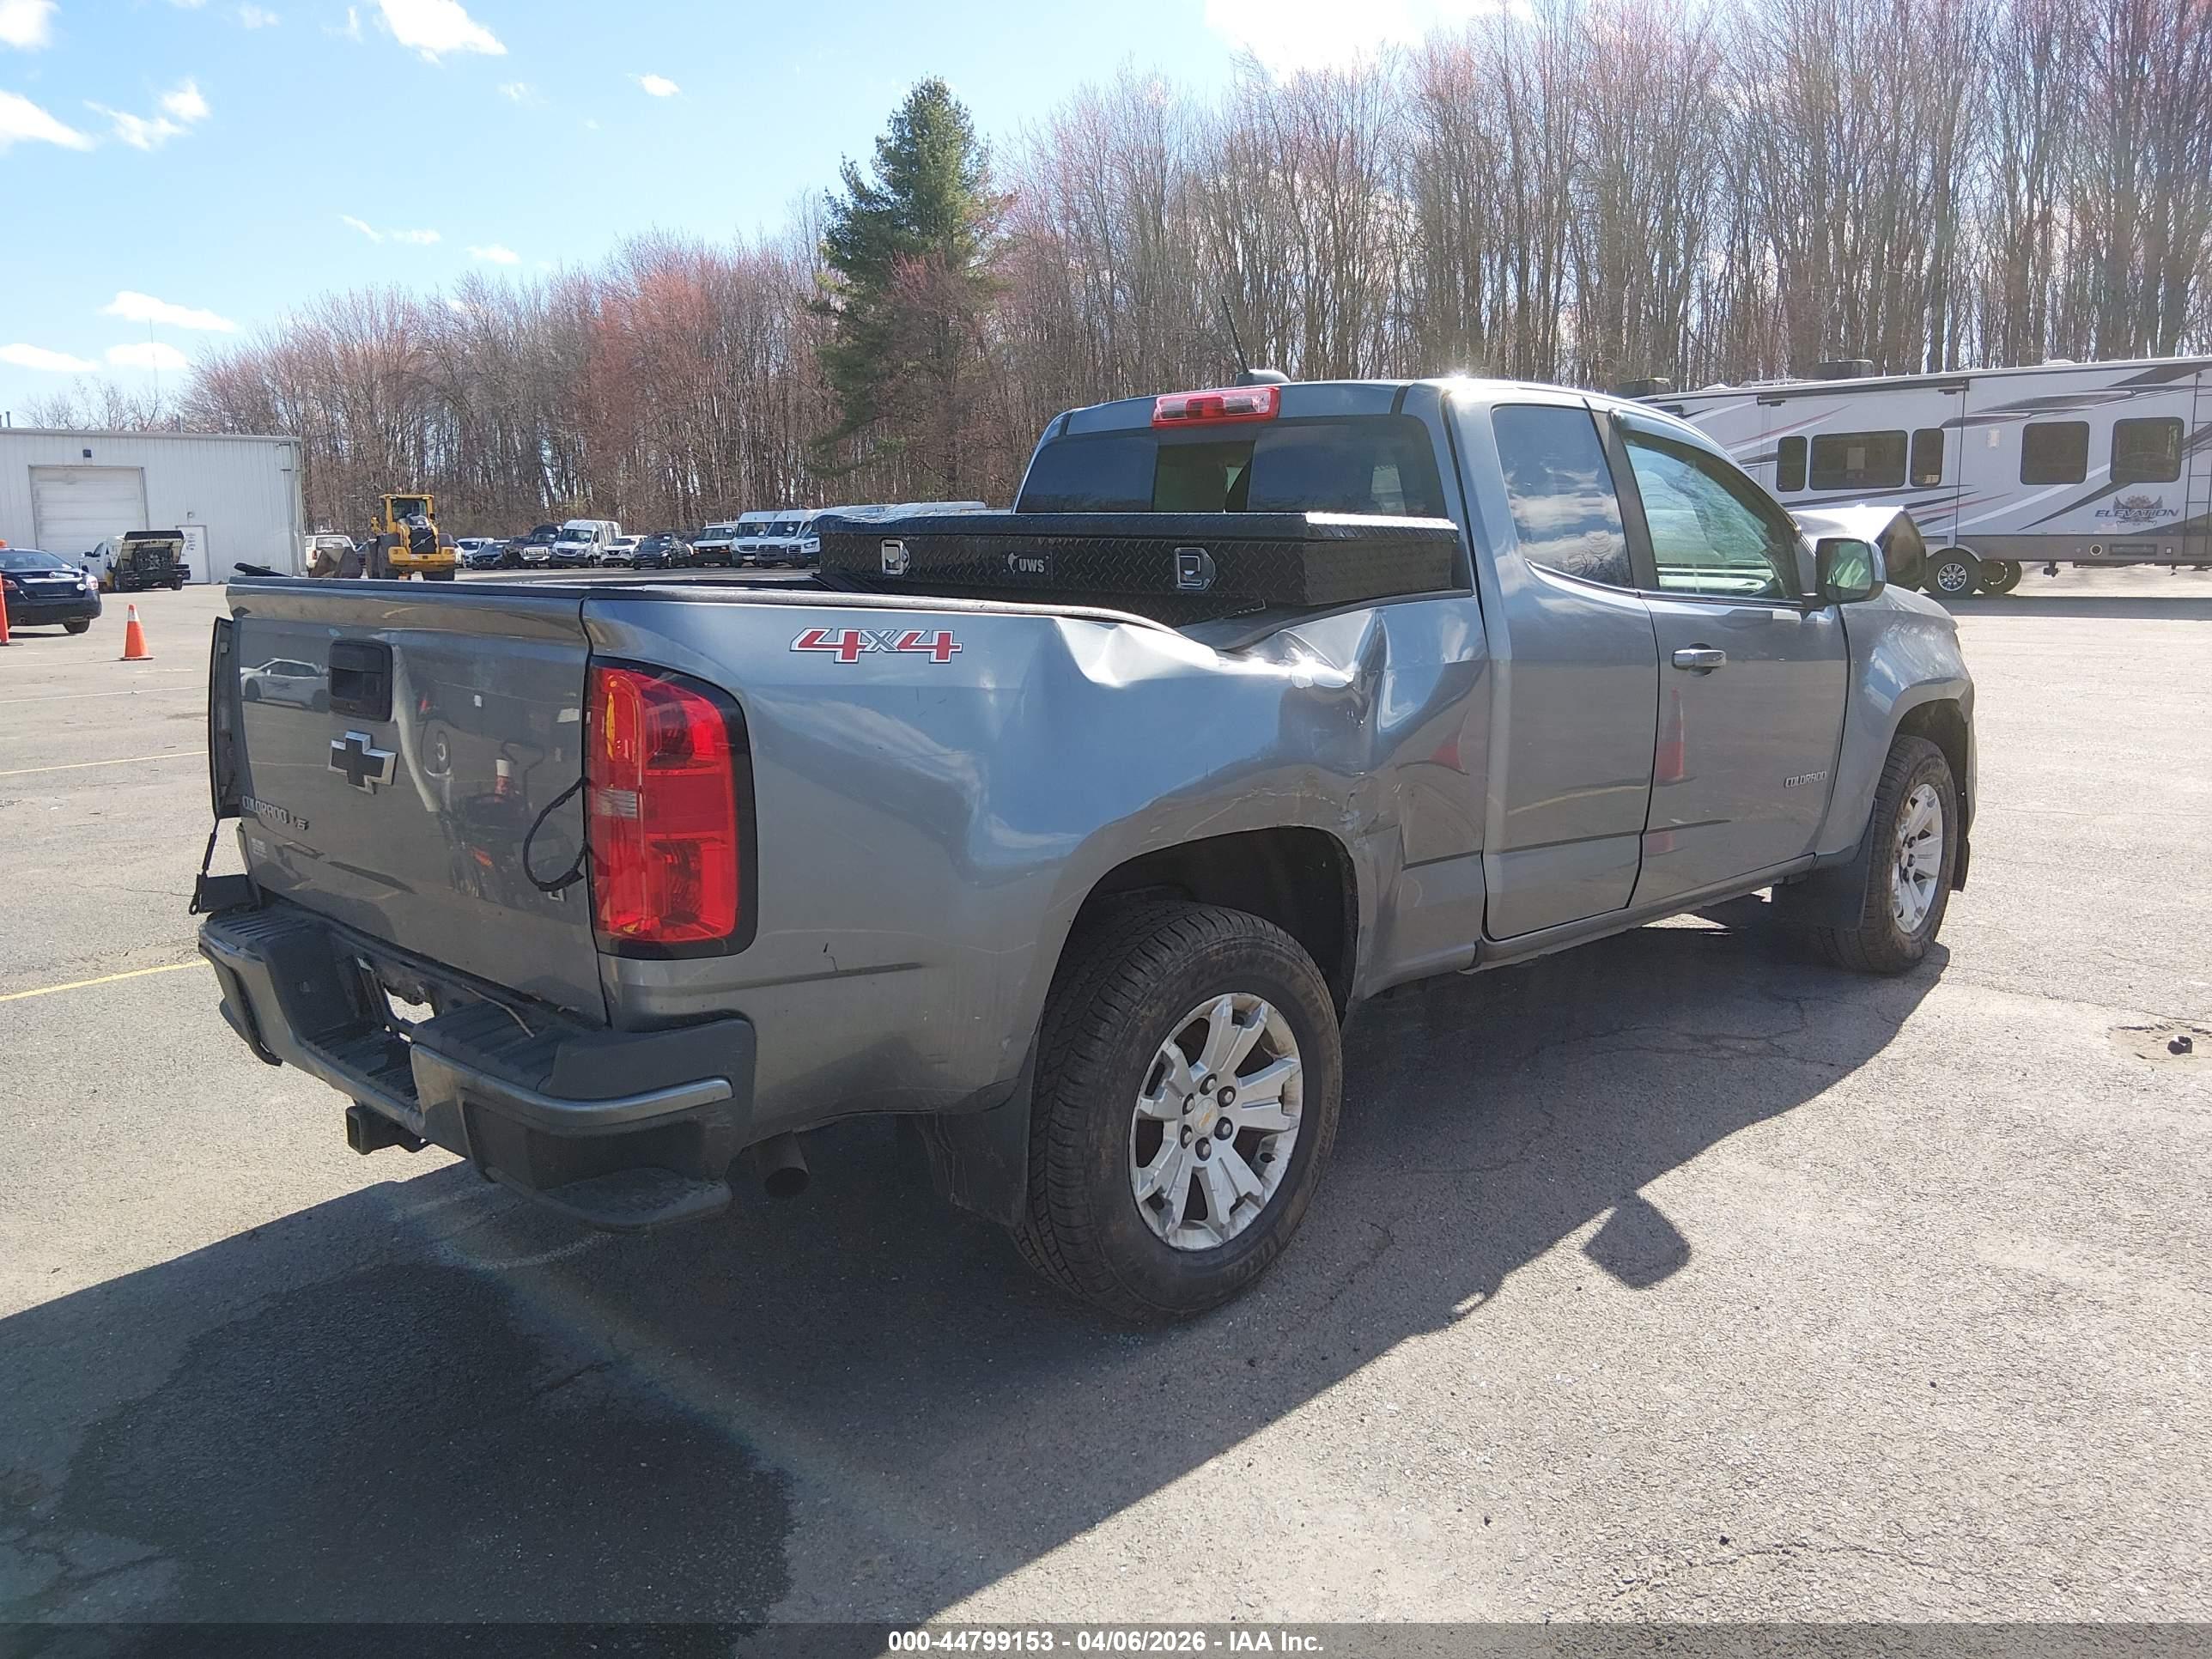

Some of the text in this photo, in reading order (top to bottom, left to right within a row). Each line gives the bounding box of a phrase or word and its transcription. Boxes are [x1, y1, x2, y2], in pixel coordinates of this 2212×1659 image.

[2094, 509, 2179, 518] ELEVATION
[1018, 558, 1045, 573] UWS
[1784, 770, 1826, 788] COLORADO
[242, 795, 289, 824] COLORADO
